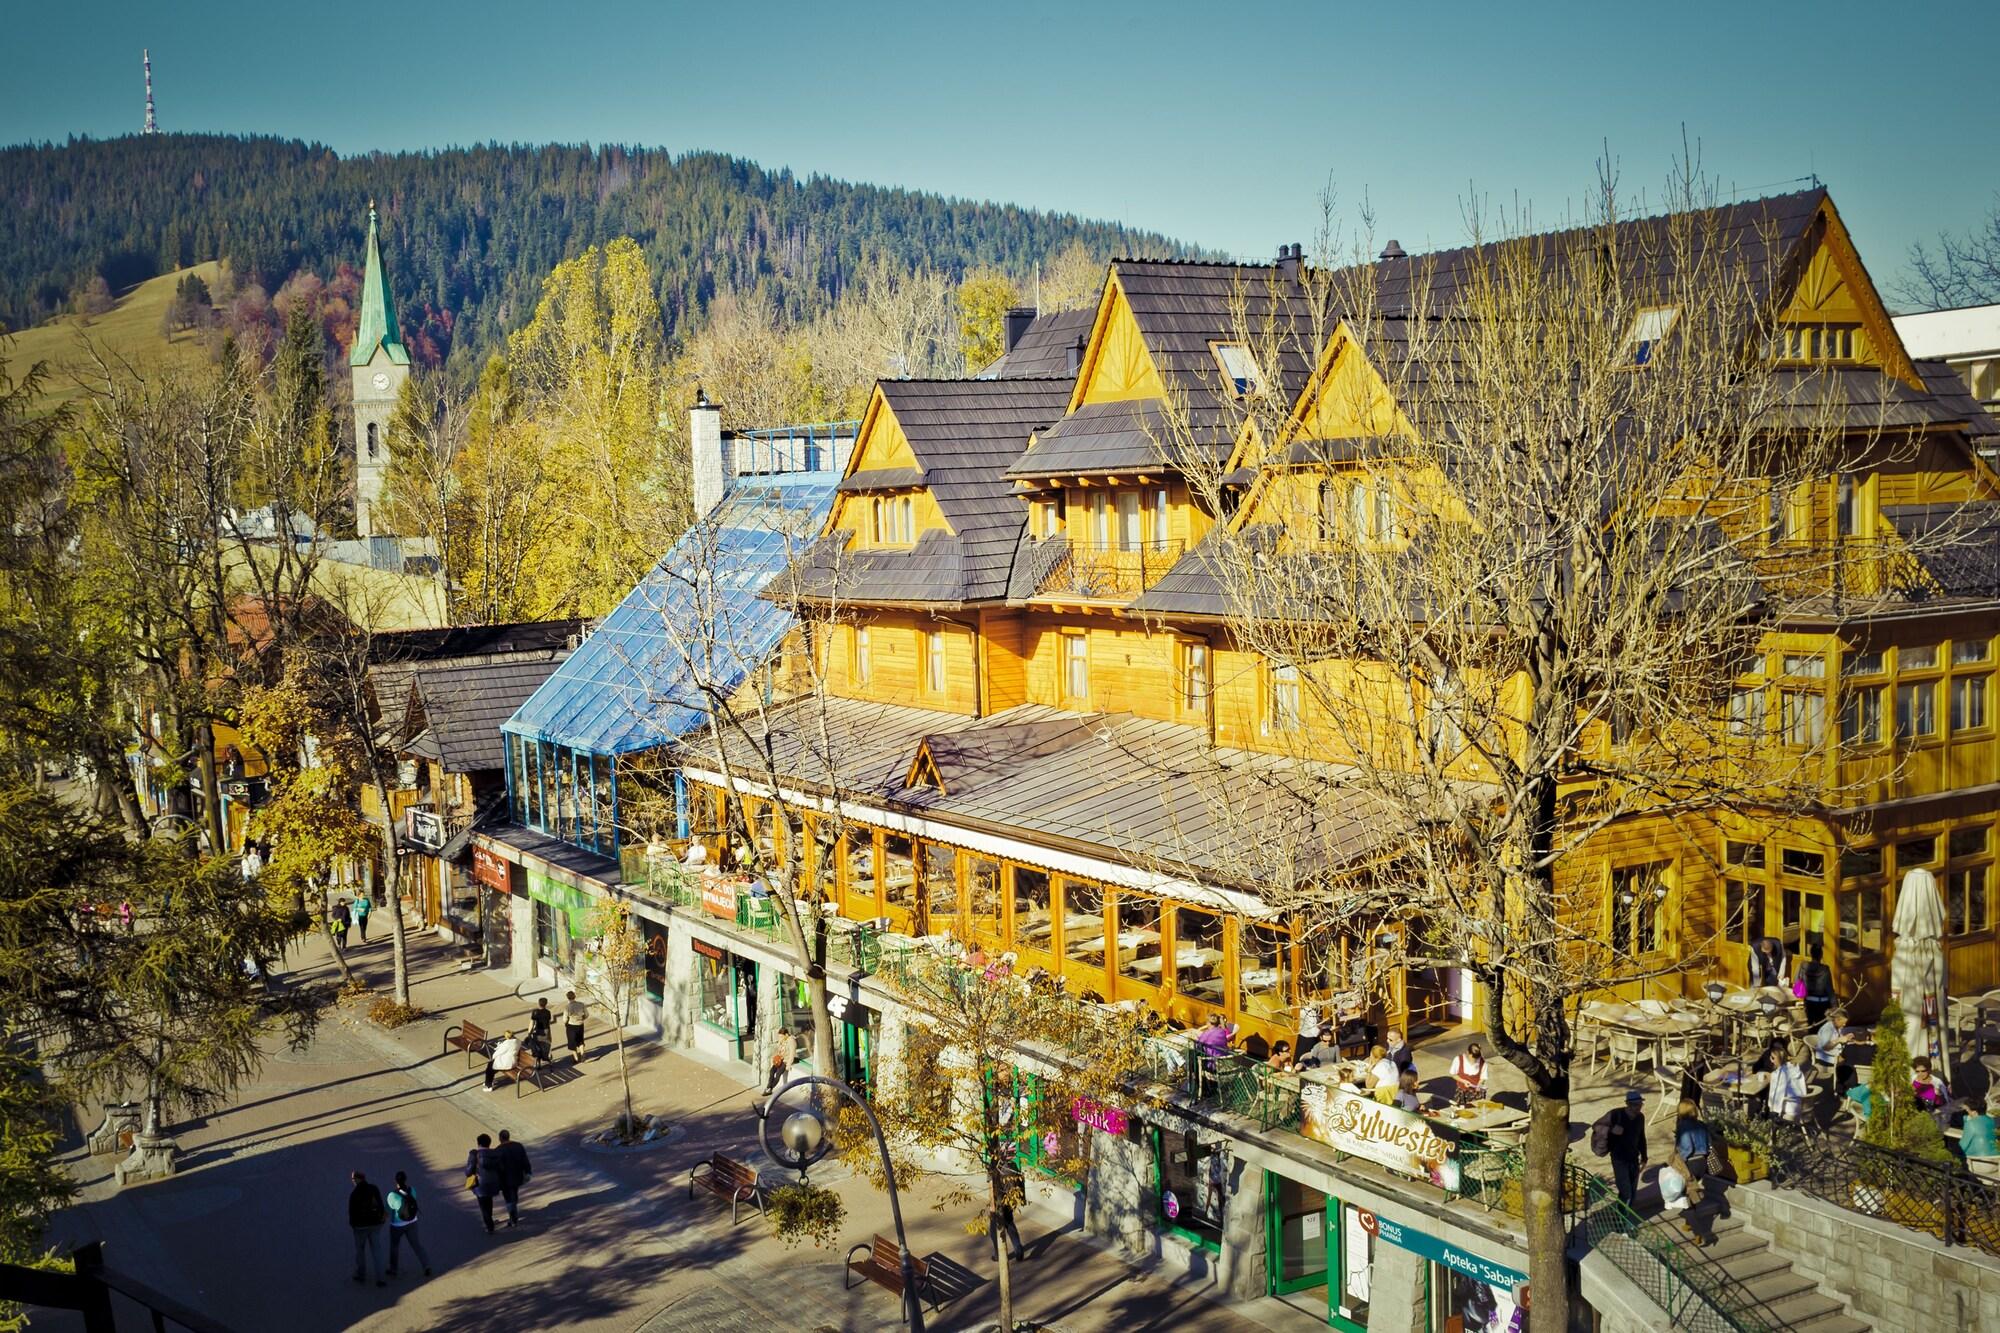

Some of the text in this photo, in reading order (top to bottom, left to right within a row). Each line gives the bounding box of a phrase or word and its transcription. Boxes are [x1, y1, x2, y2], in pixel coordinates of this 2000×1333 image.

[1329, 1100, 1455, 1164] Sylwester
[1378, 1220, 1402, 1237] BONUS
[1443, 1248, 1478, 1274] Apteka
